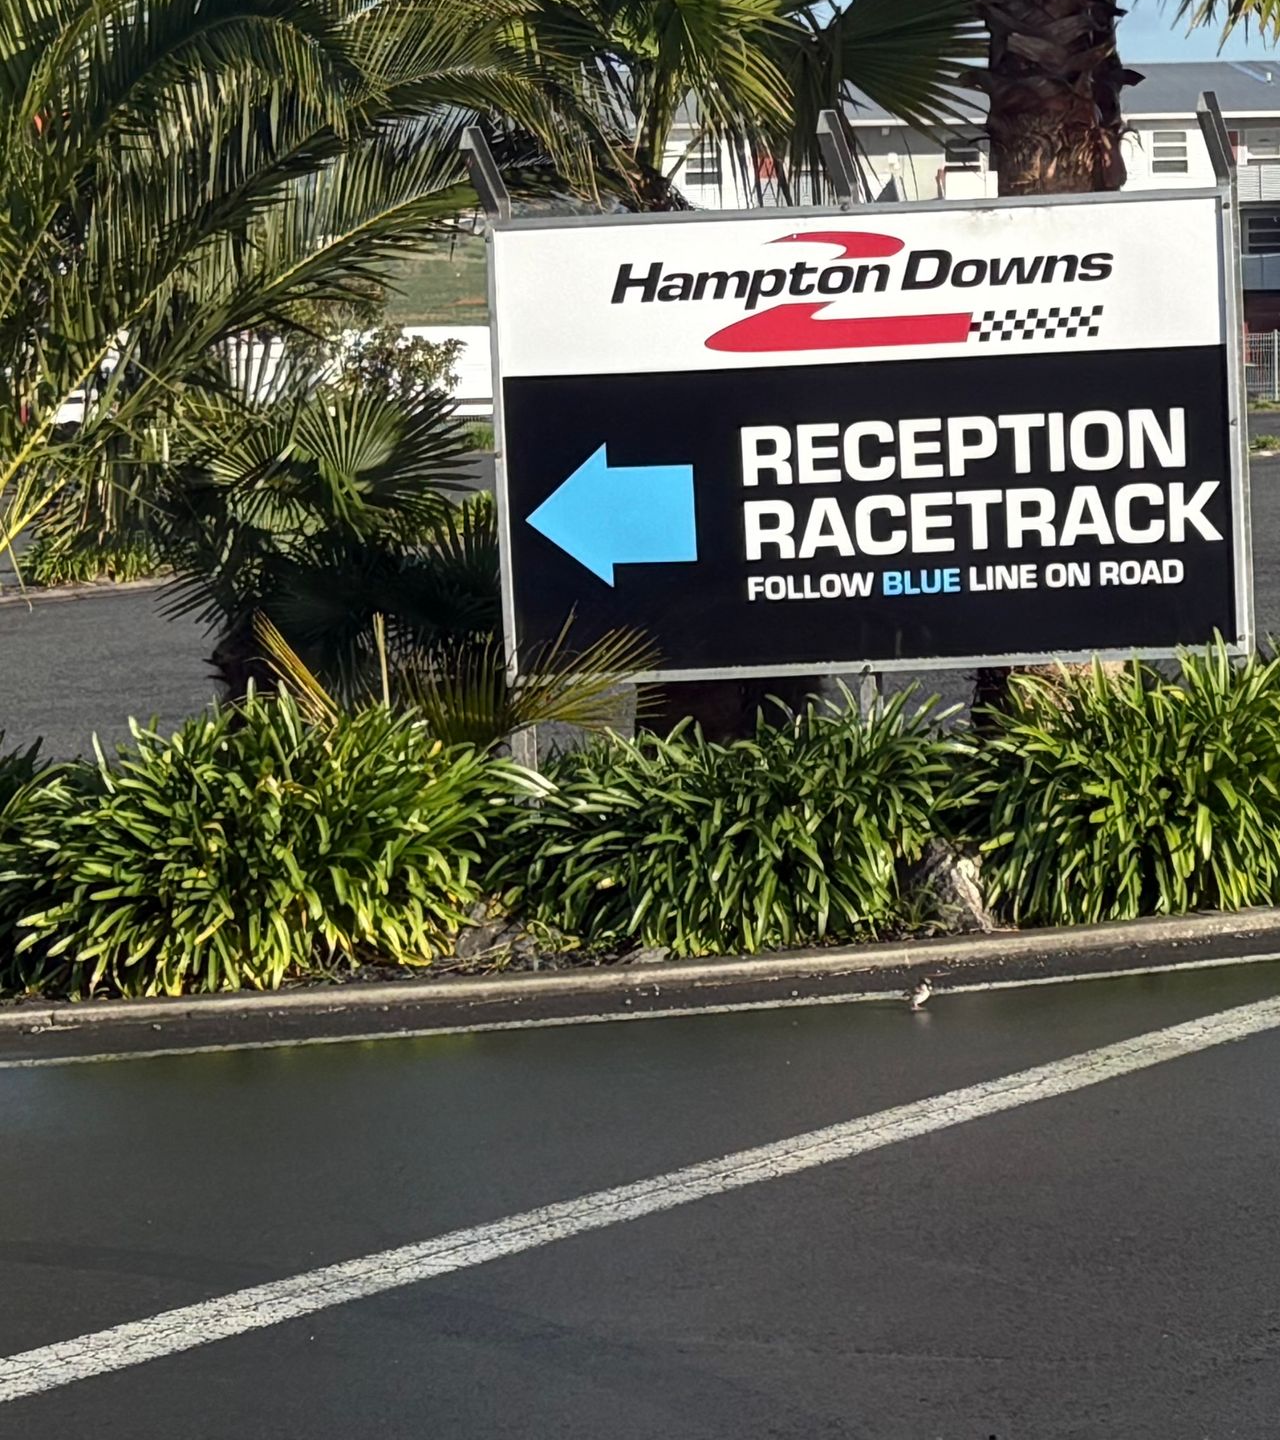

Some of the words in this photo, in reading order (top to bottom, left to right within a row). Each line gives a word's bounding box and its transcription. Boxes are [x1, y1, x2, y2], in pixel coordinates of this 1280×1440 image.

[611, 259, 891, 310] Hampton
[901, 249, 1114, 291] Downs
[740, 407, 1187, 487] RECEPTION
[744, 481, 1224, 560] RACETRACK
[747, 571, 874, 603] FOLLOW
[882, 568, 961, 596] BLUE
[969, 564, 1038, 591] LINE
[1045, 562, 1091, 588] ON
[1099, 558, 1184, 587] ROAD
